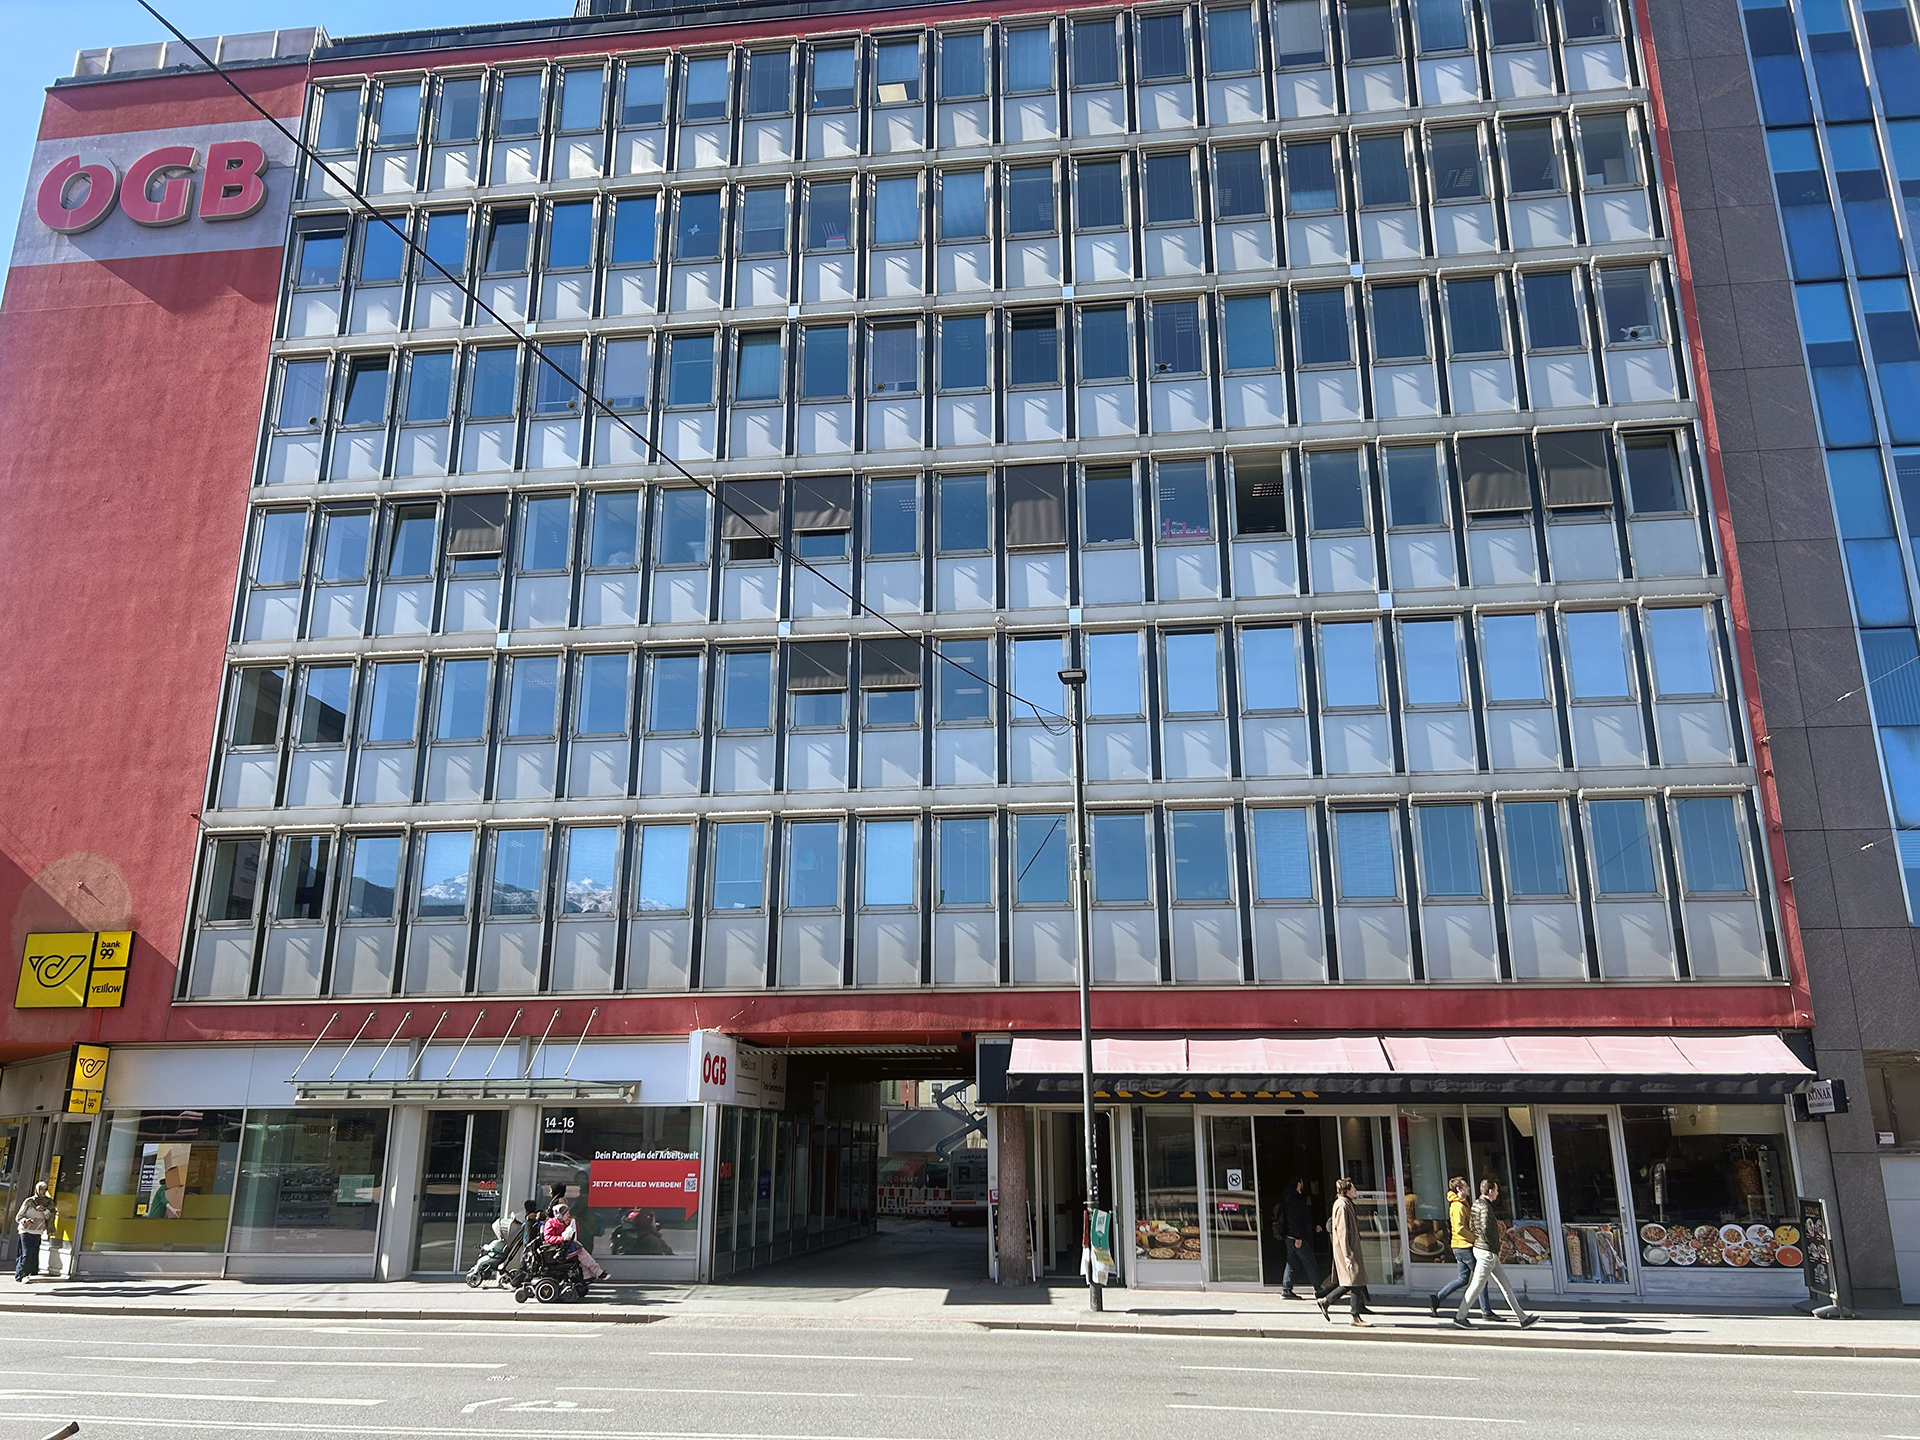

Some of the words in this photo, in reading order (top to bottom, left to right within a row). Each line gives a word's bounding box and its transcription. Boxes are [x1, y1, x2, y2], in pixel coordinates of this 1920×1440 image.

[100, 948, 114, 960] 99
[87, 1101, 95, 1109] 99
[544, 1116, 575, 1128] 14-16
[595, 1150, 611, 1159] Dein
[647, 1150, 658, 1159] der
[659, 1150, 699, 1160] Arbeitswelt
